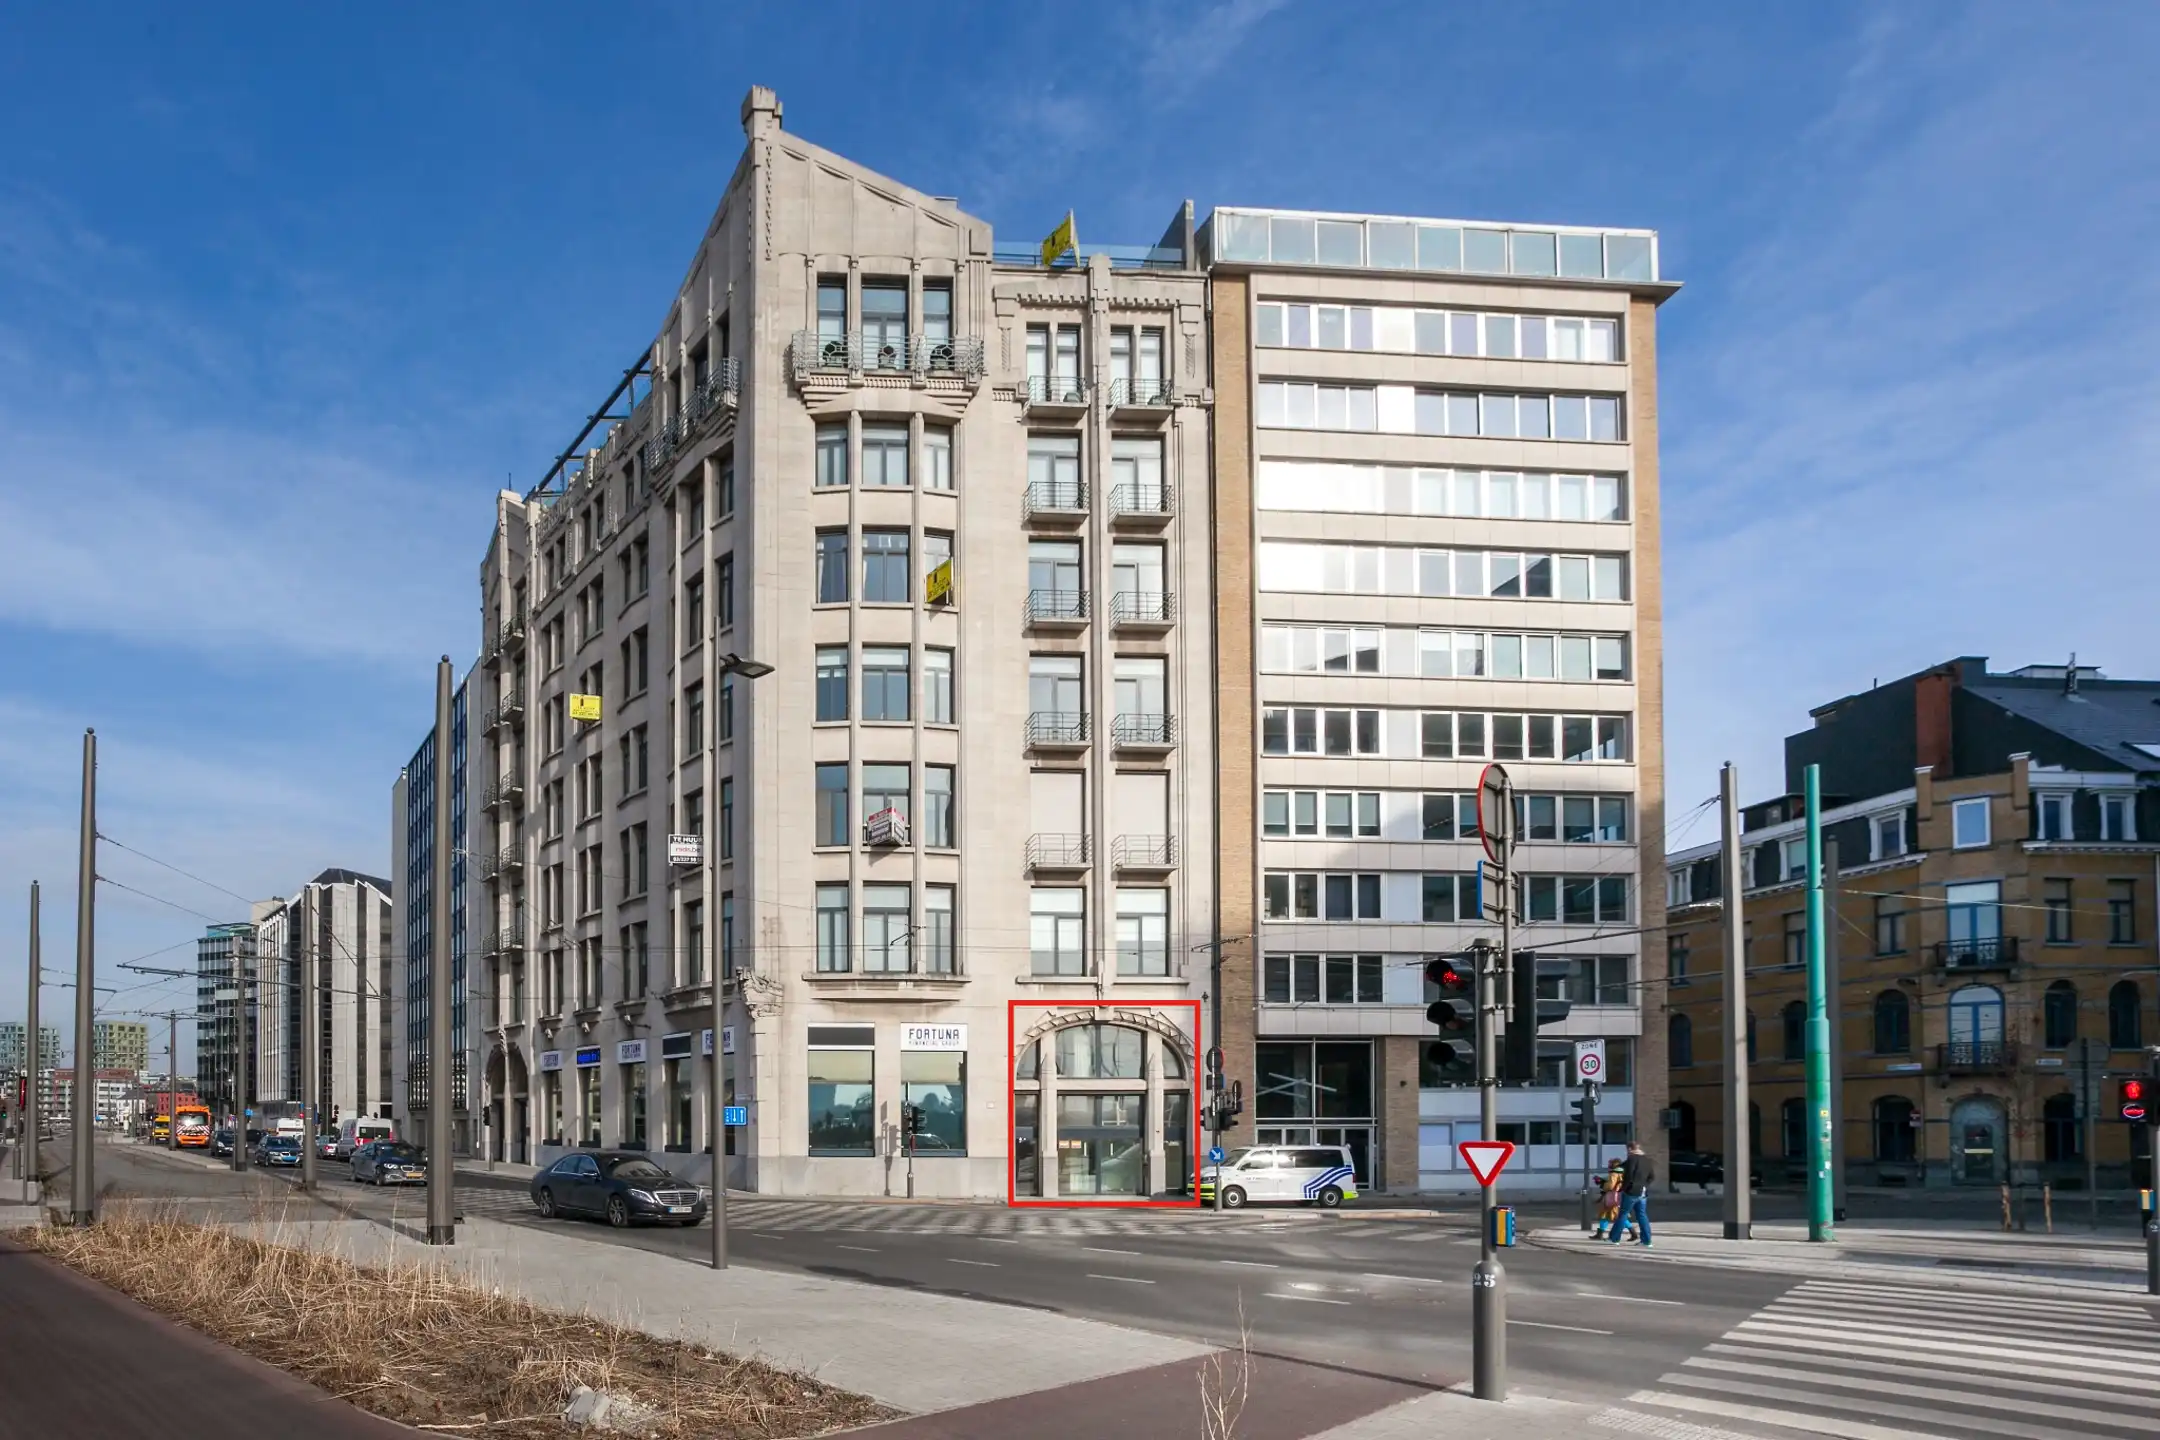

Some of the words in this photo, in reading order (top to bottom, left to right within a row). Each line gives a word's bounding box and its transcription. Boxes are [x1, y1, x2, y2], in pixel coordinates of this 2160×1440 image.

[908, 1028, 960, 1040] FORTUNA
[621, 1043, 641, 1055] FORTUNA
[1584, 1060, 1597, 1070] 30
